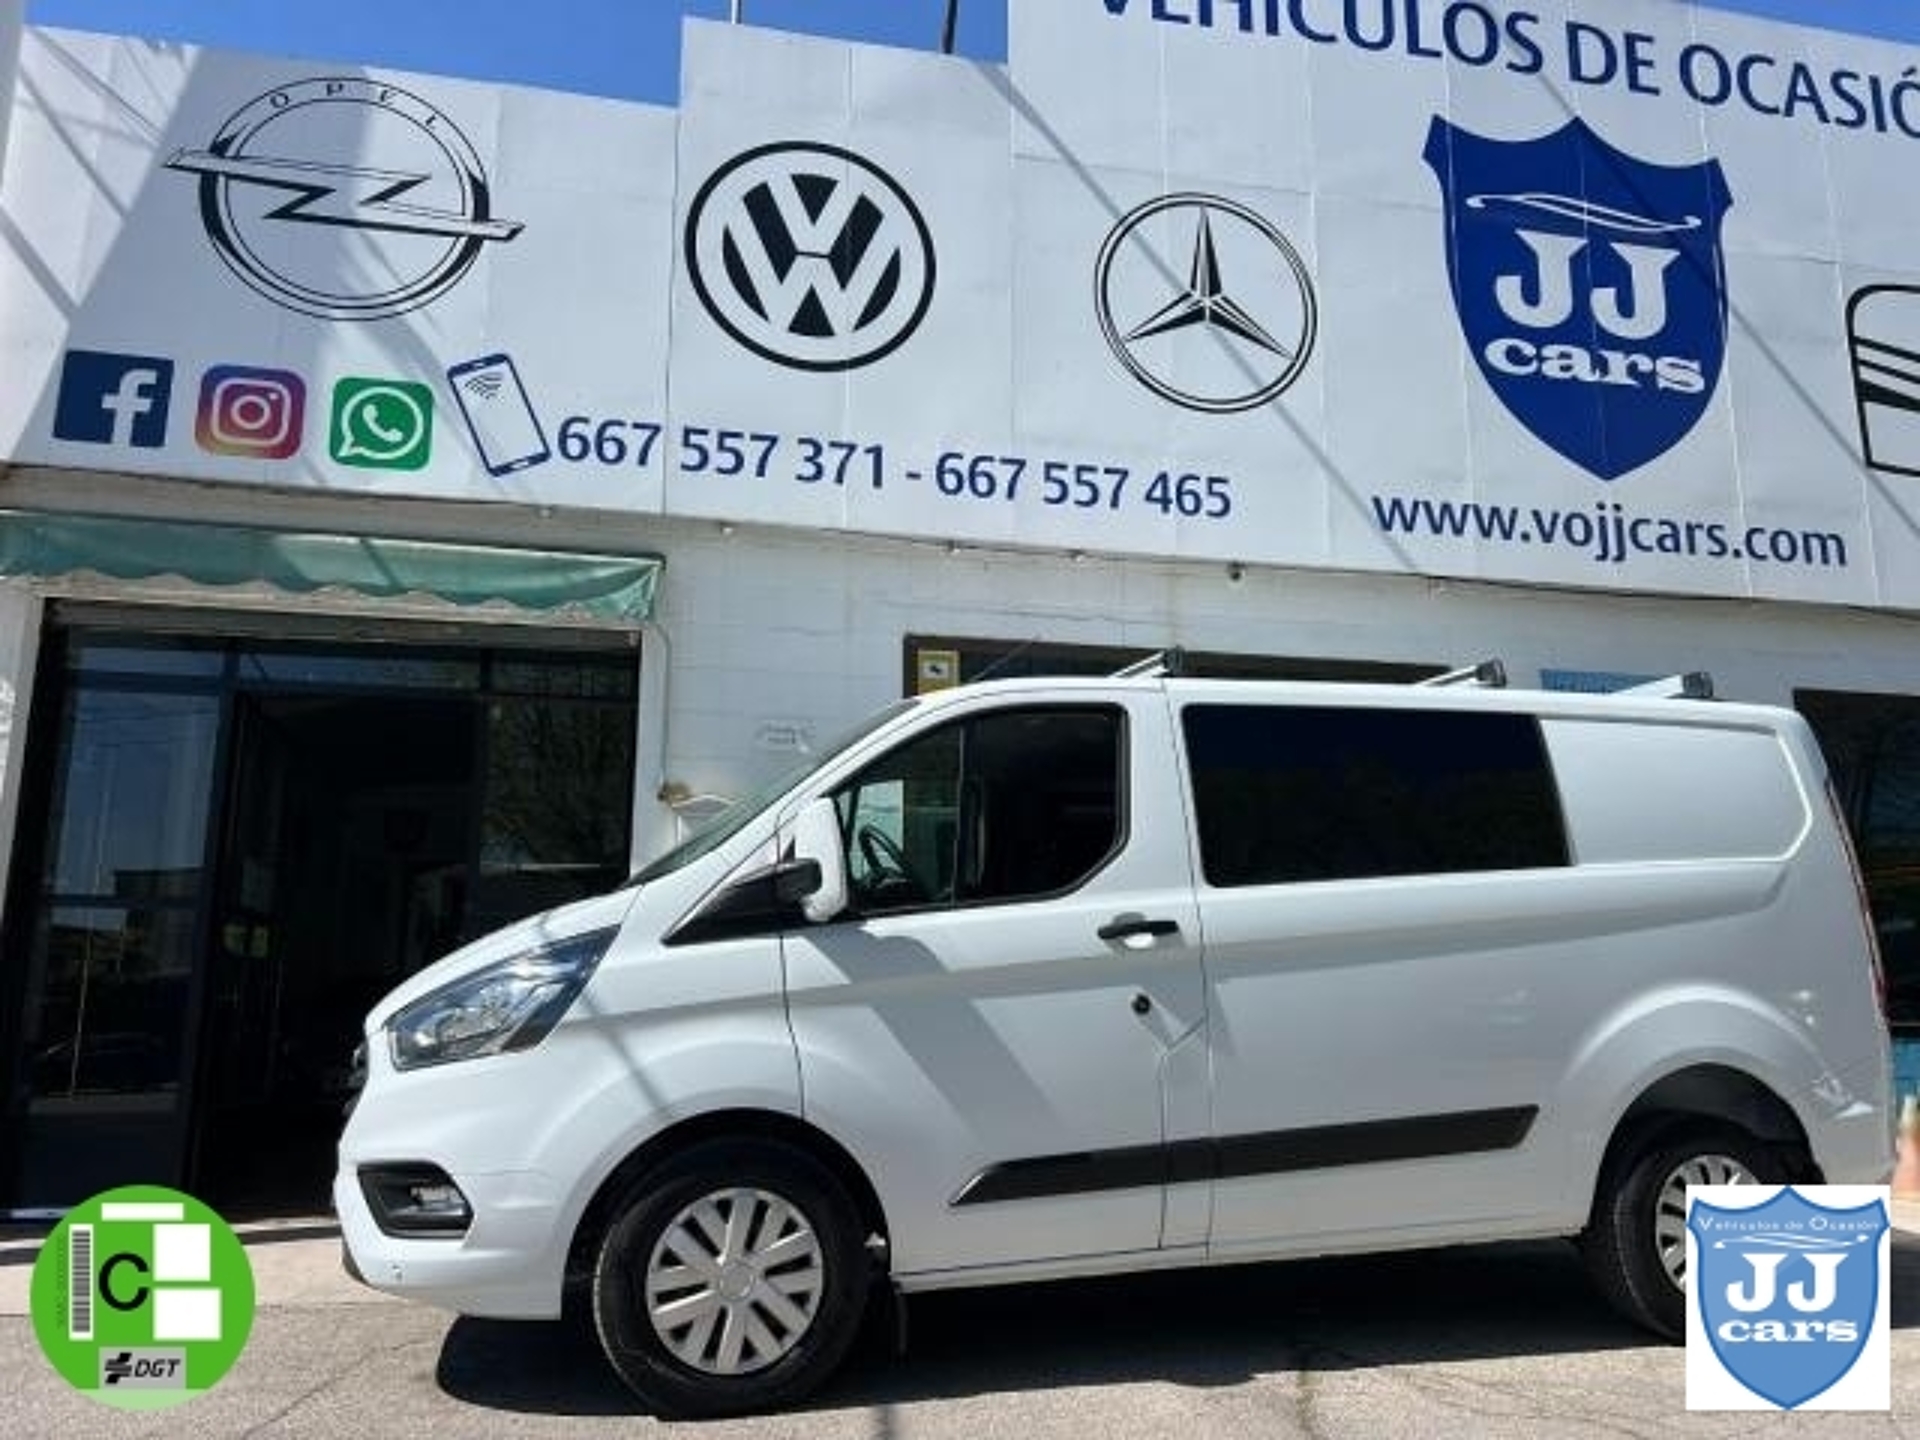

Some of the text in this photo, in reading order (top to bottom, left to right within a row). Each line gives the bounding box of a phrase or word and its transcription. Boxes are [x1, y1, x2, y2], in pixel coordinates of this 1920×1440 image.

[1565, 21, 1661, 97] DE
[269, 82, 444, 130] OPEL
[1494, 229, 1681, 340] JJ
[1484, 337, 1706, 394] cars
[556, 415, 662, 467] 667
[679, 426, 779, 478] 557
[794, 436, 885, 489] 371
[934, 451, 1027, 501] 667
[1041, 462, 1130, 509] 557
[1143, 471, 1232, 518] 465
[1372, 494, 1847, 567] www.vojjcars.com
